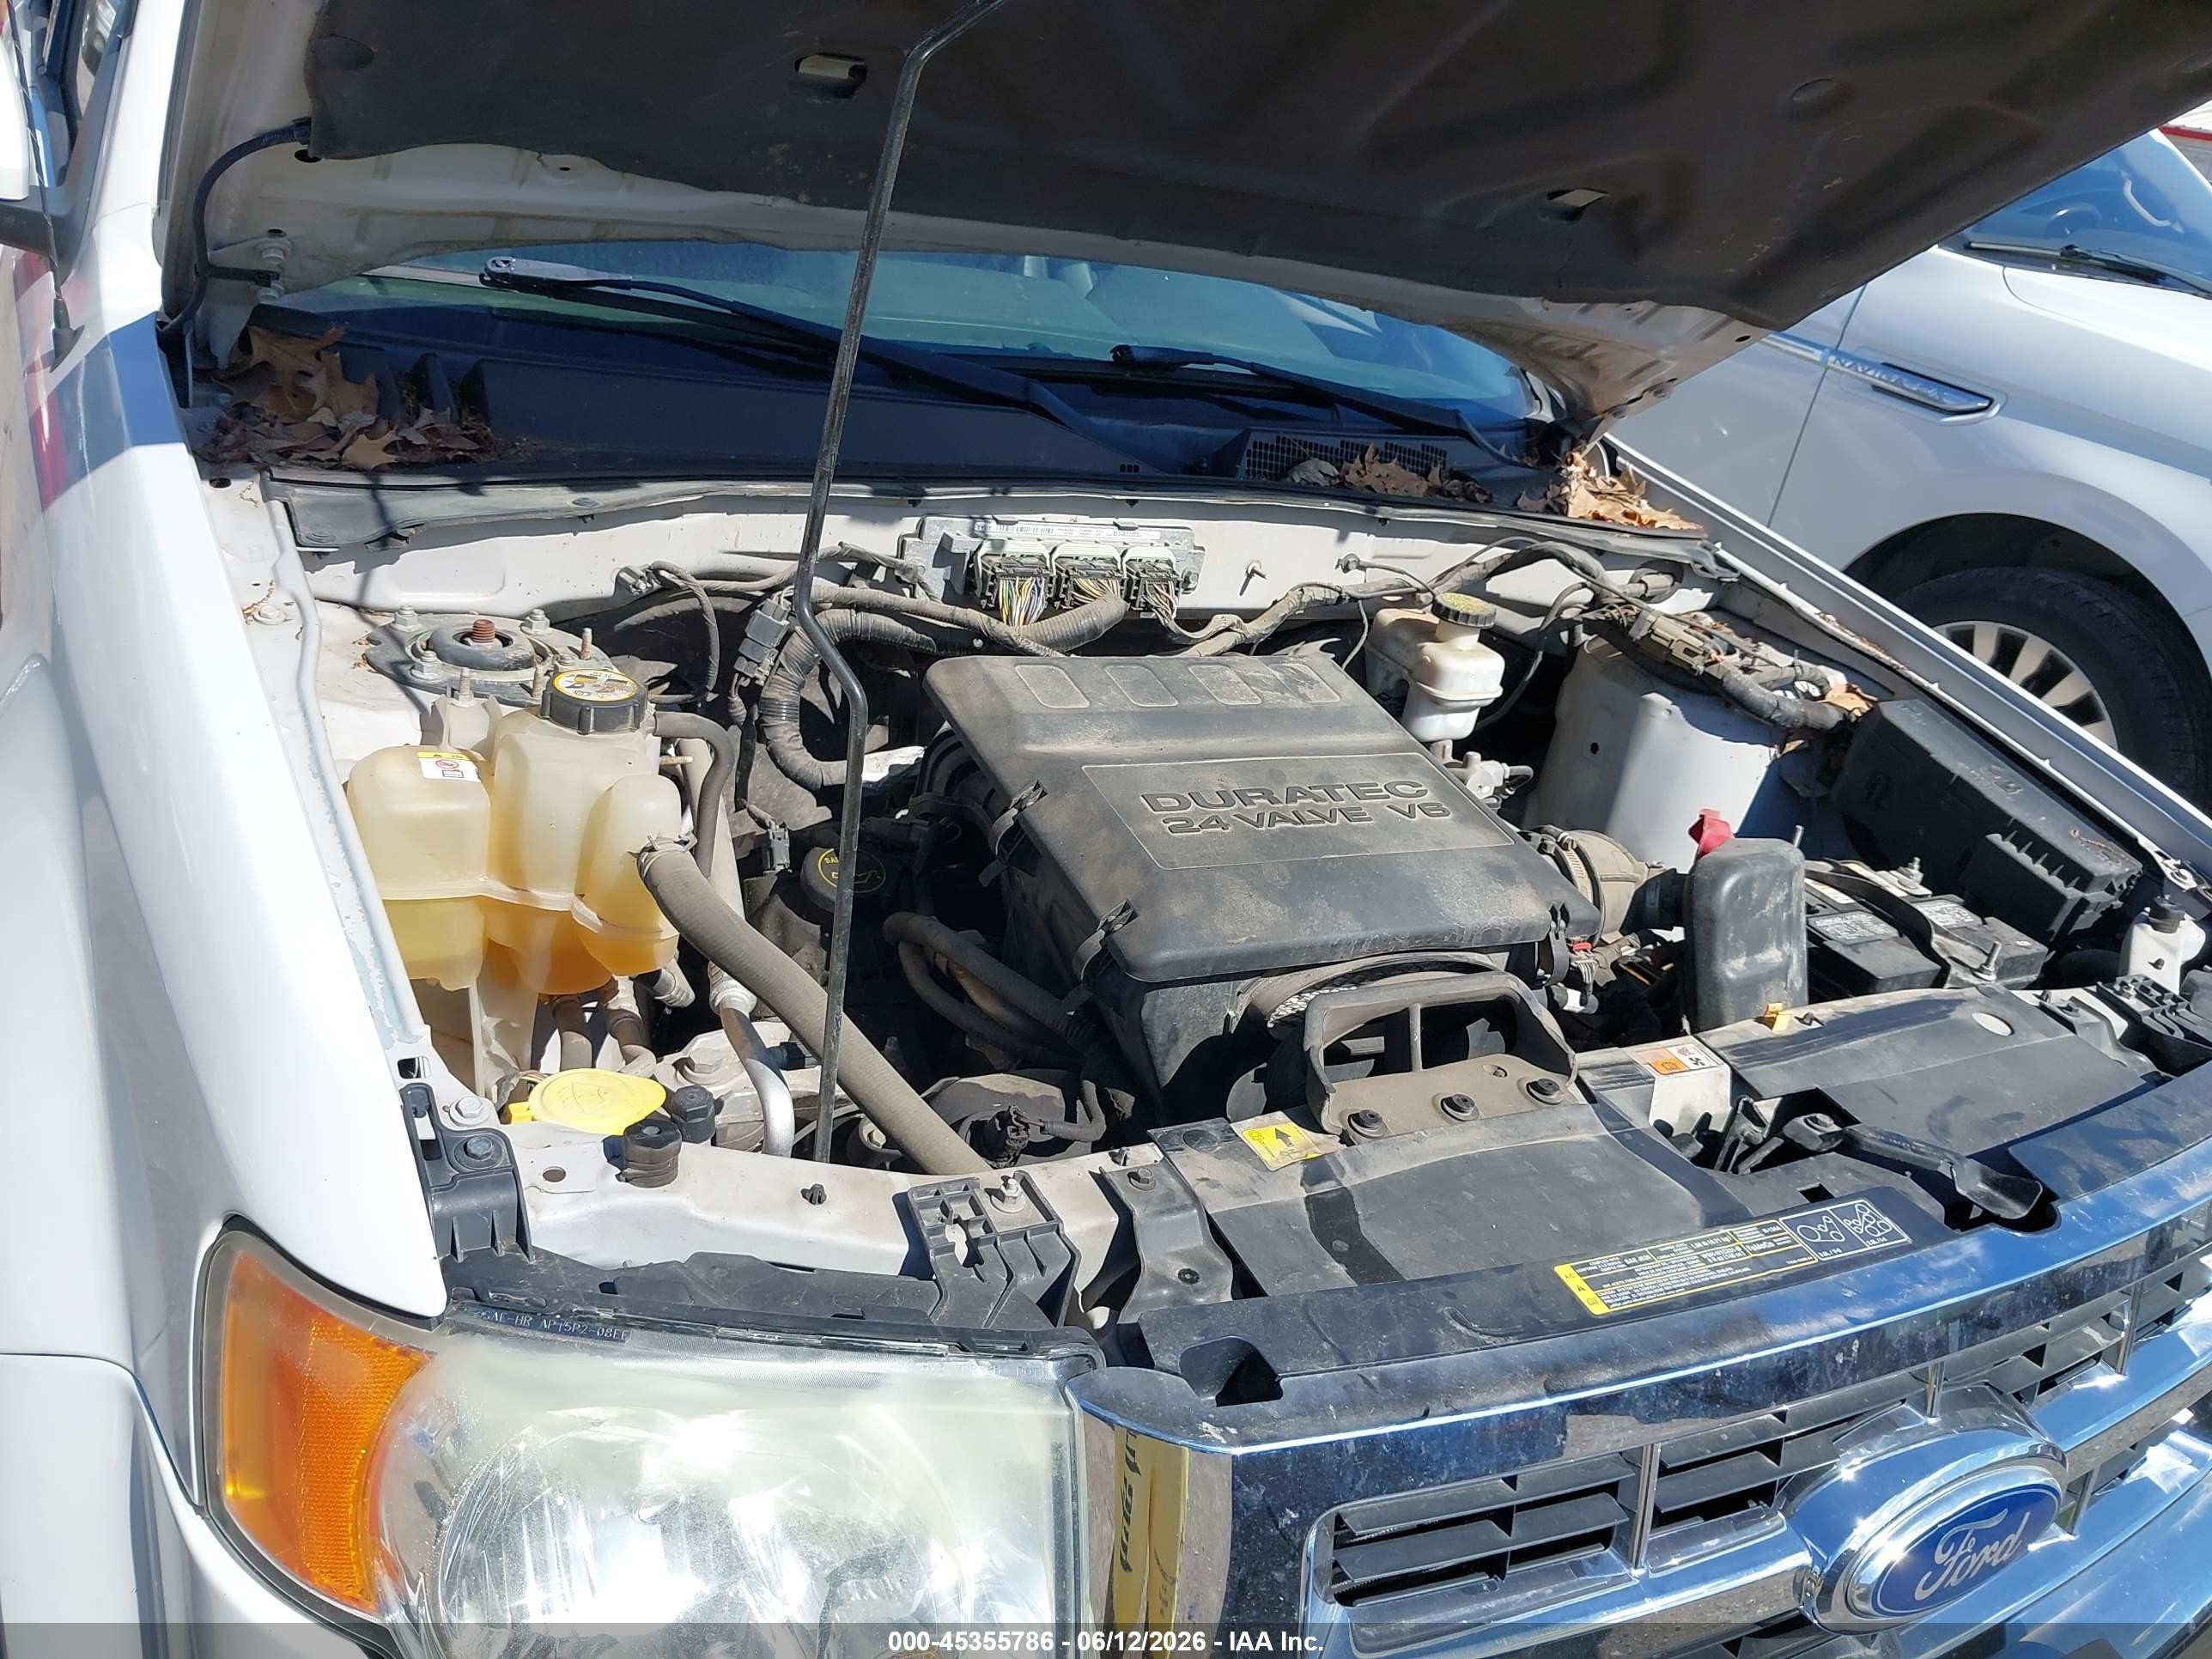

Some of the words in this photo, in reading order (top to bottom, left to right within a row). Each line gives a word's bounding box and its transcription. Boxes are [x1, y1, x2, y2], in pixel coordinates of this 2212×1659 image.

[1141, 780, 1429, 813] DURATEC
[1162, 813, 1231, 836] 24
[1233, 805, 1374, 830] VALVE
[1386, 801, 1452, 821] V6
[1914, 1507, 2032, 1601] Ford
